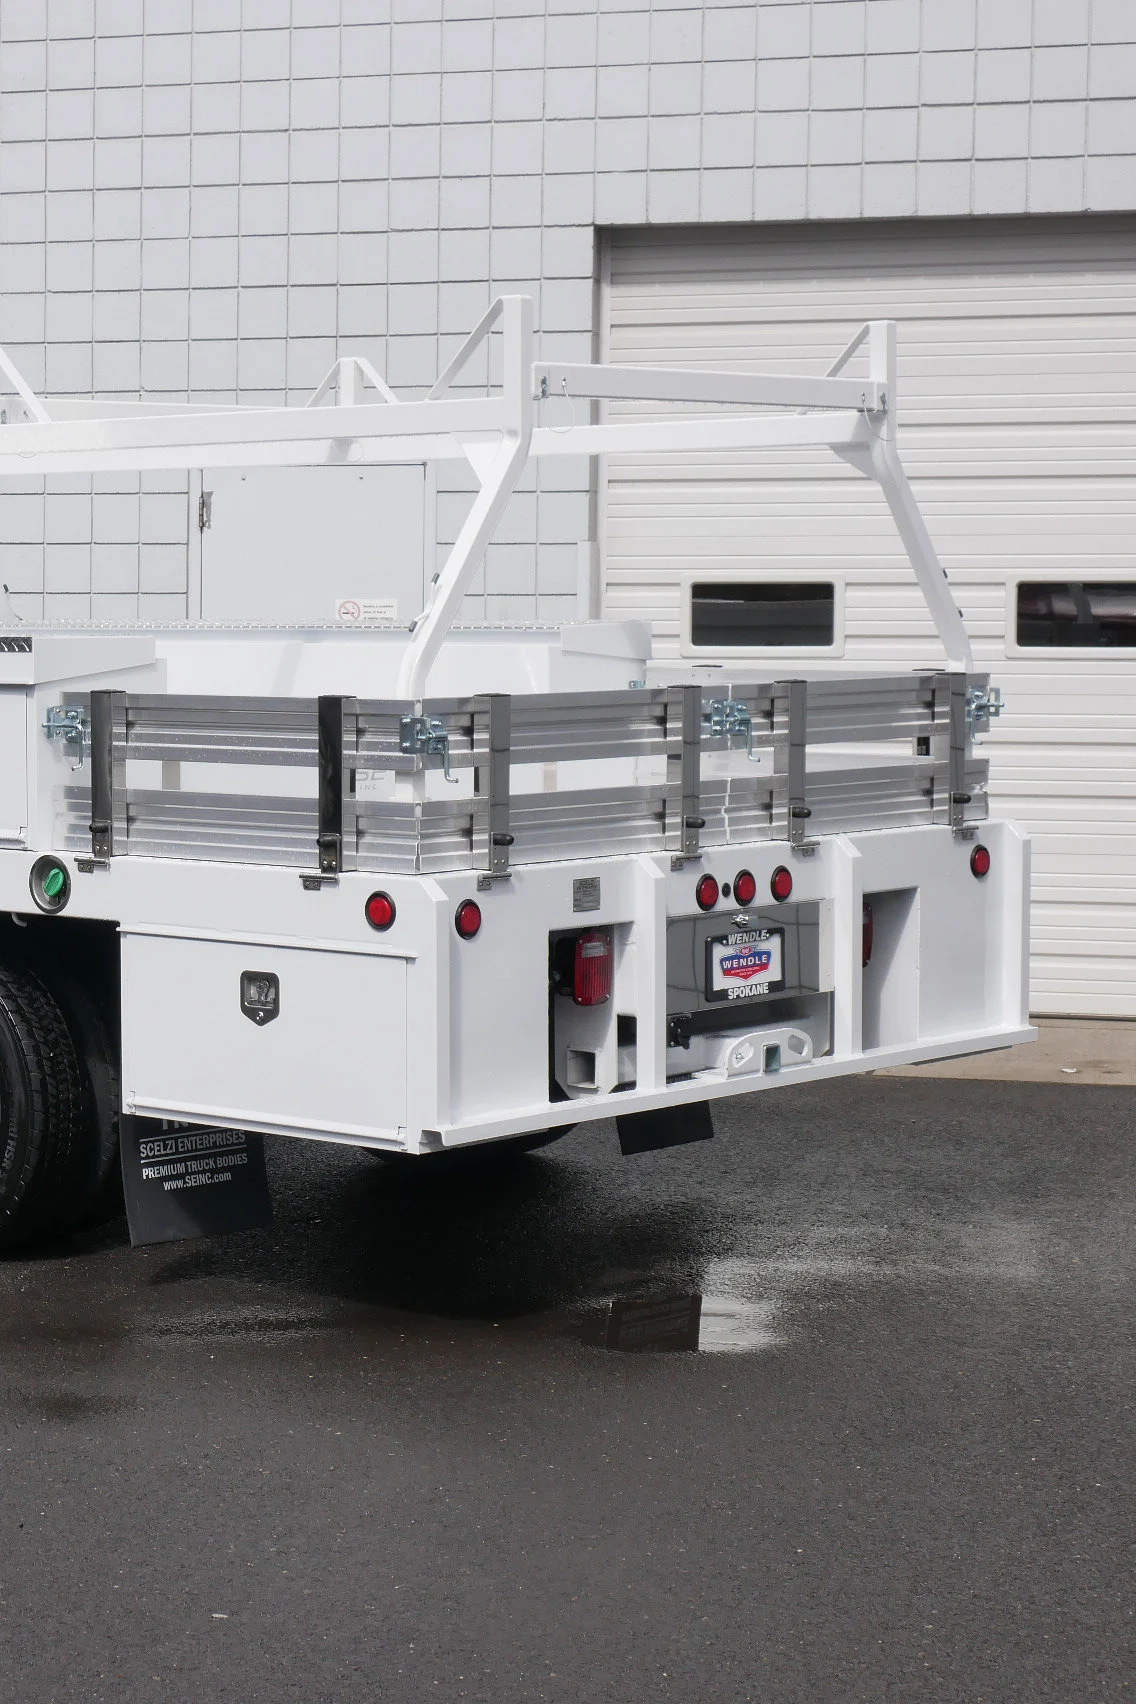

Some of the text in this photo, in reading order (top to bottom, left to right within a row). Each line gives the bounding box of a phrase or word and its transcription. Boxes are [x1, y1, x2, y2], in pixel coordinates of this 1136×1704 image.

[728, 929, 768, 945] WENDLE
[722, 955, 768, 969] WENDLE
[728, 982, 770, 1000] SPOKANE
[139, 1130, 246, 1158] SCELZI ENTERPRISES
[142, 1152, 248, 1180] PREMIUM TRUCK BODIES
[163, 1171, 232, 1191] www.SEINC.com
